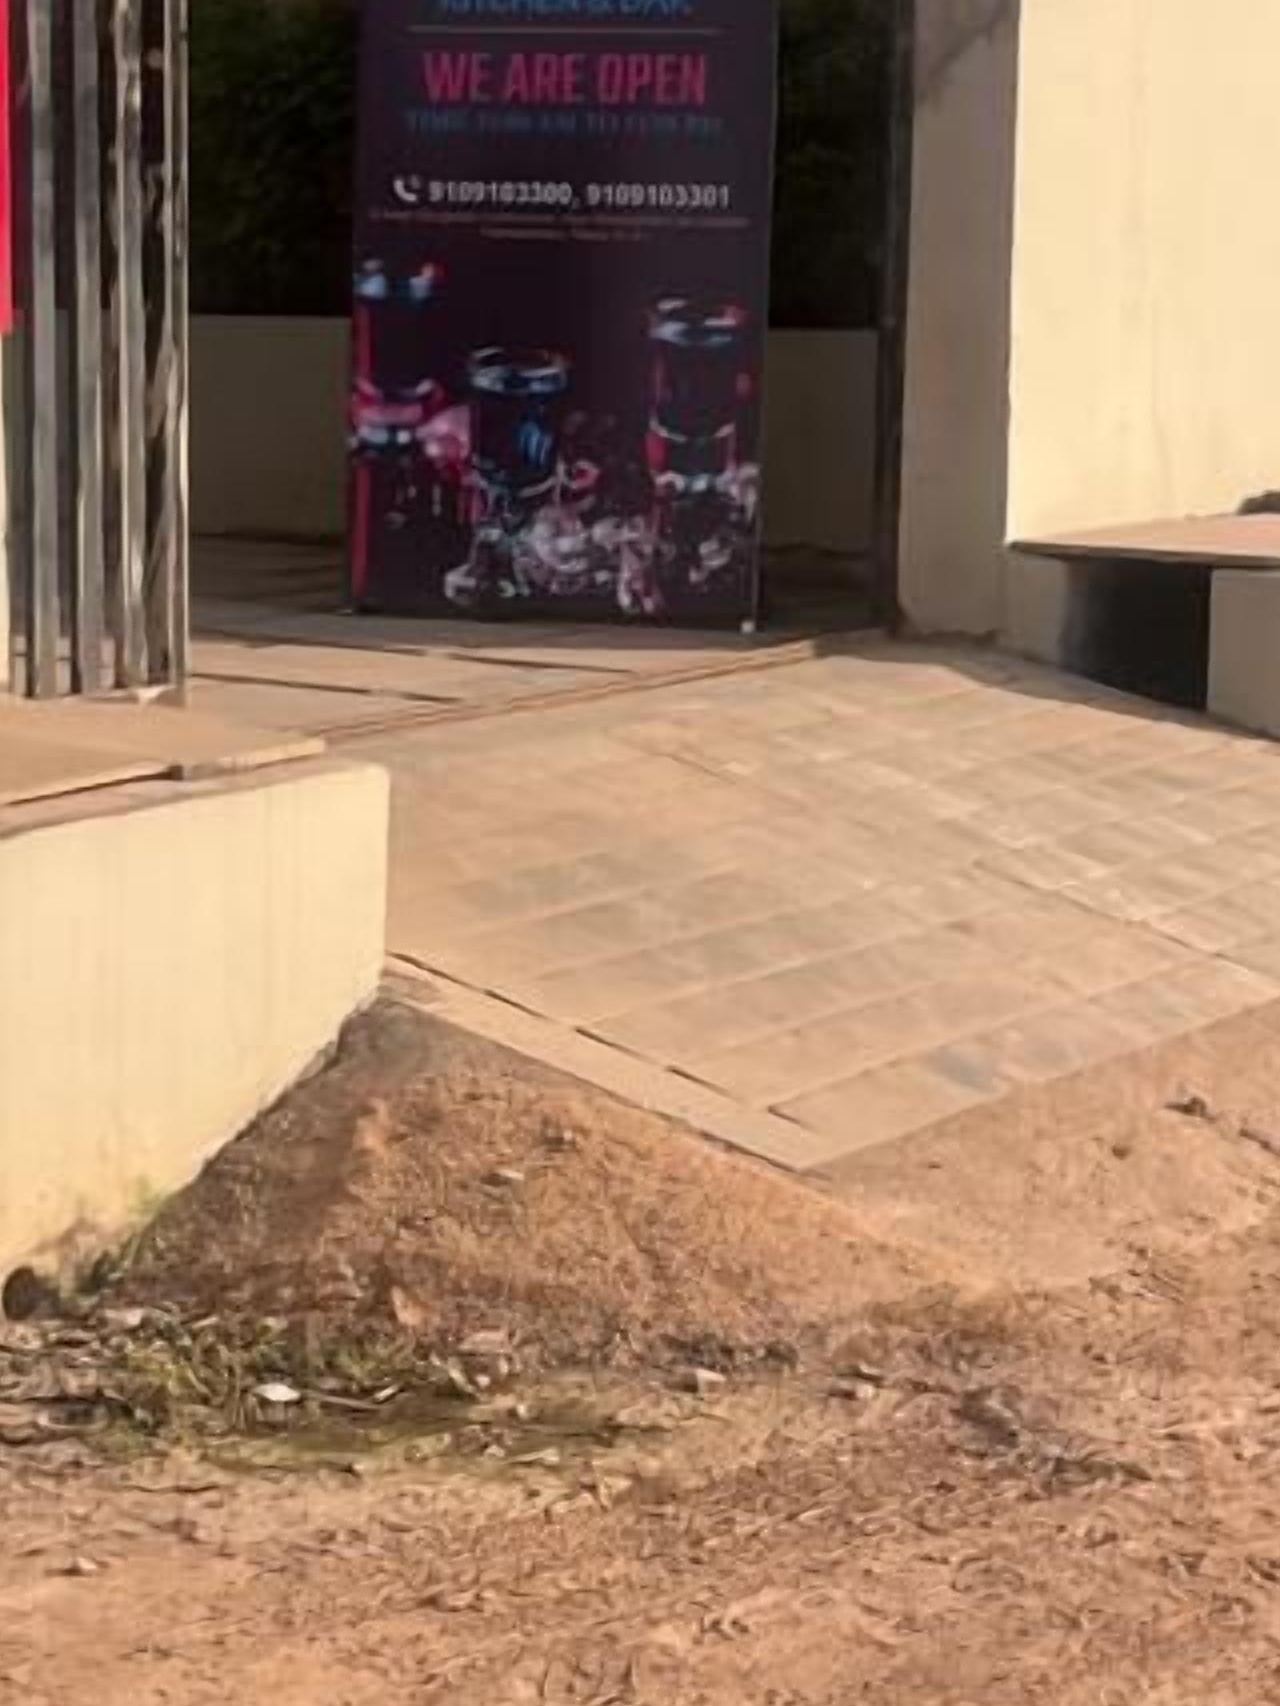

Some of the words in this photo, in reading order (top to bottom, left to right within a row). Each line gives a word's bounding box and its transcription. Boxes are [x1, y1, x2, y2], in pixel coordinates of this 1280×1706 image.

[423, 52, 492, 103] WE
[504, 52, 586, 104] ARE
[596, 53, 706, 106] OPEN
